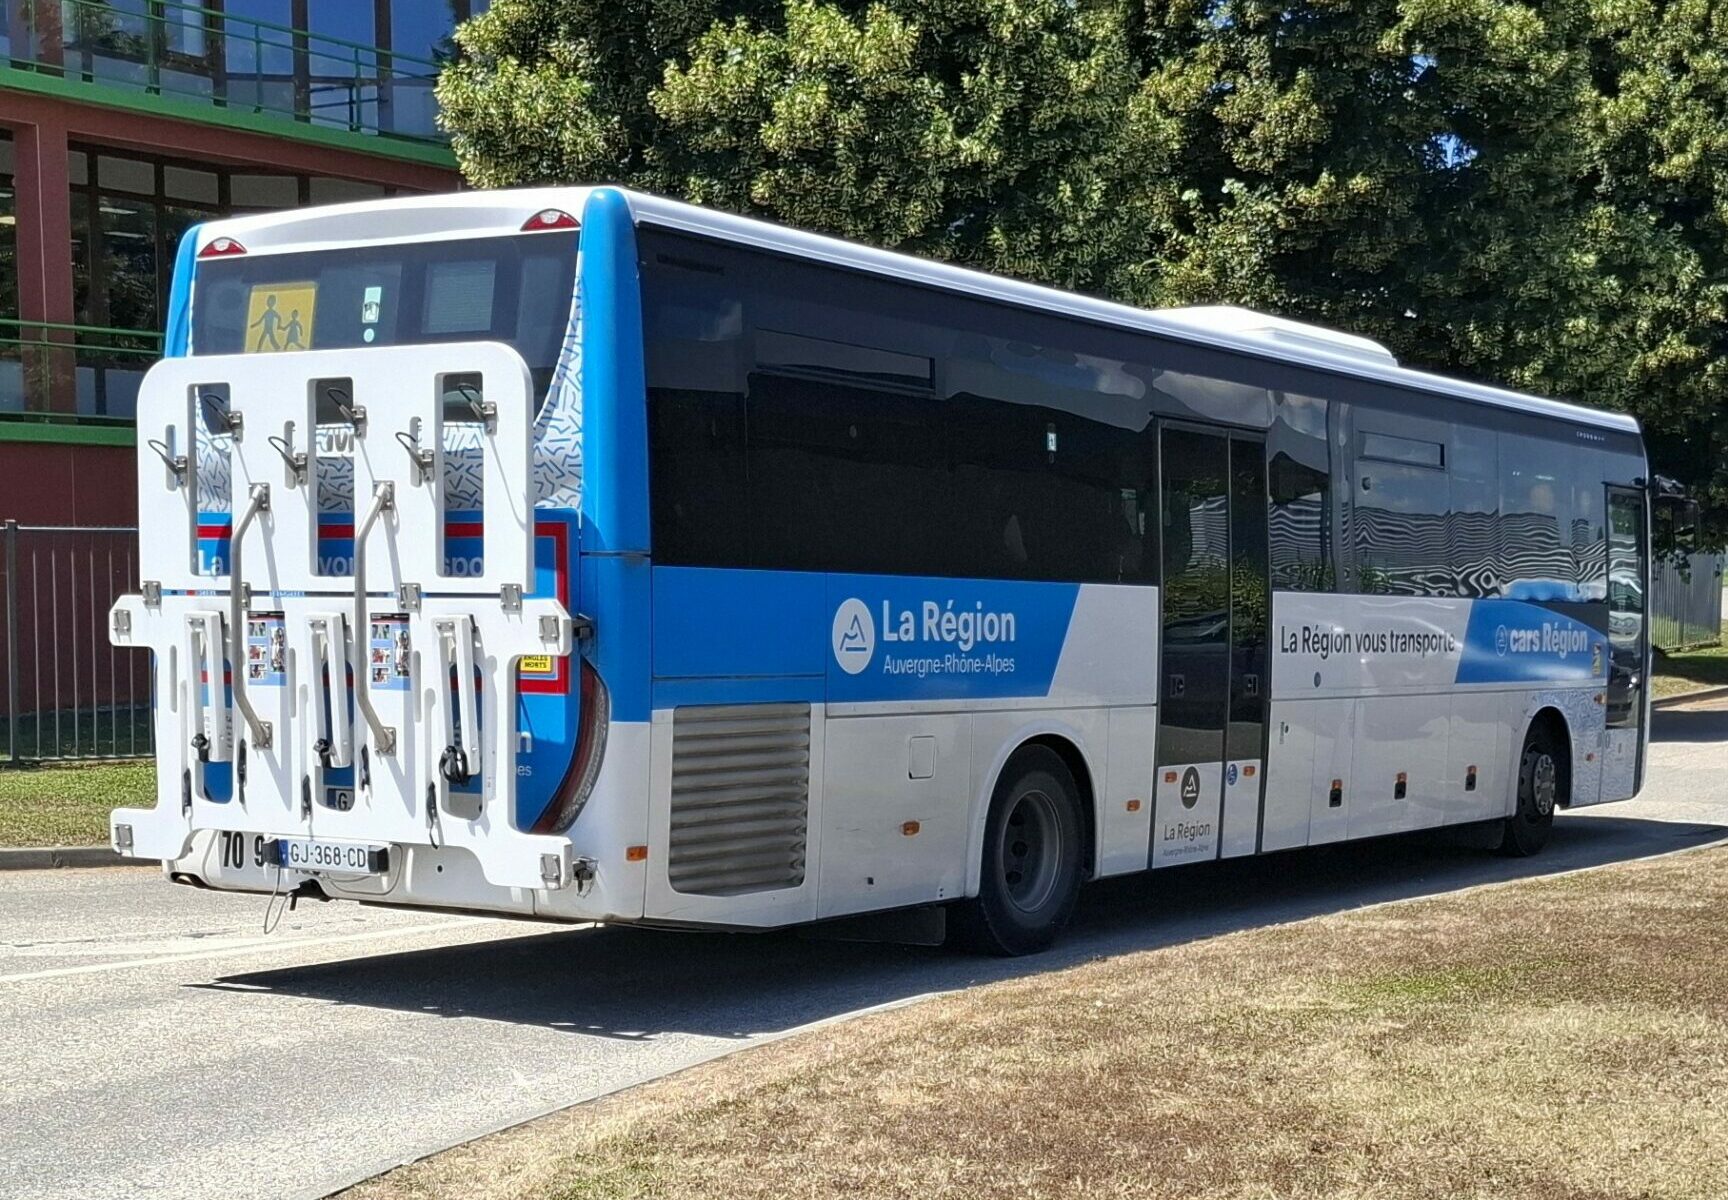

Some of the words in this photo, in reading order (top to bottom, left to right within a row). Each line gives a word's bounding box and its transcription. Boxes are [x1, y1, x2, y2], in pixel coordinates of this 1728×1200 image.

[883, 600, 915, 642] La
[923, 600, 1016, 651] Région
[1281, 625, 1298, 653] La
[1302, 625, 1352, 659] Région
[1355, 632, 1387, 653] vous
[1390, 630, 1455, 657] transporte
[1509, 628, 1540, 652] cars
[1542, 622, 1588, 659] Région
[883, 653, 1015, 678] Auvergne-Rhône-Alpes
[1164, 824, 1175, 841] La
[1177, 821, 1211, 842] Région
[222, 831, 244, 869] 70
